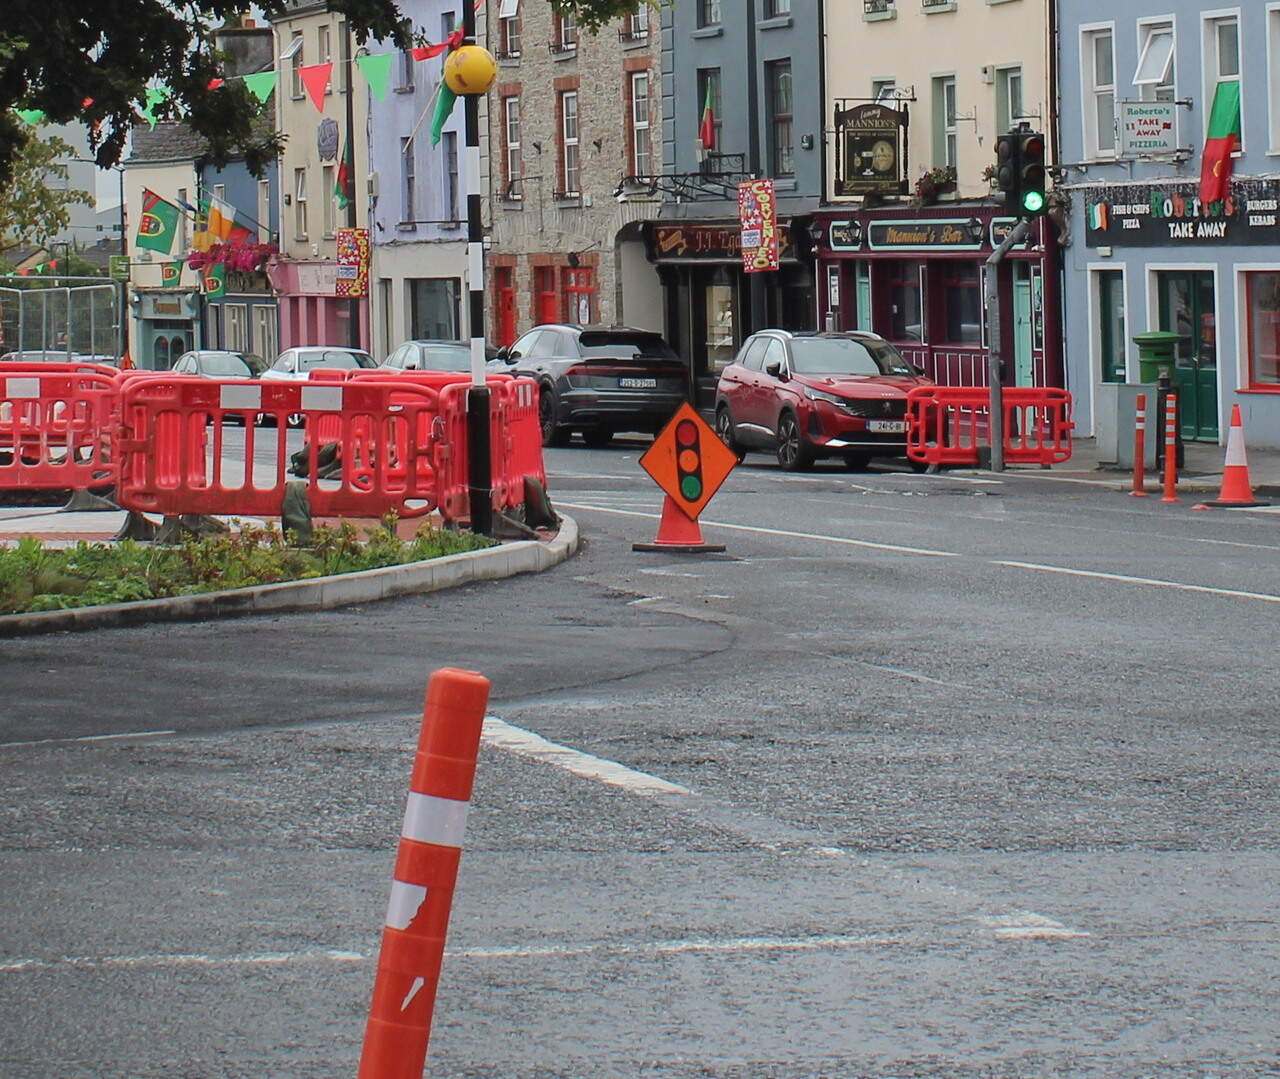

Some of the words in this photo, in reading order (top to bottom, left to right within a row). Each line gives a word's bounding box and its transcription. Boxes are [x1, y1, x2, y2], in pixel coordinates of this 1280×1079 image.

[1138, 118, 1159, 126] TAKE
[1168, 222, 1194, 238] TAKE
[1196, 222, 1227, 238] AWAY
